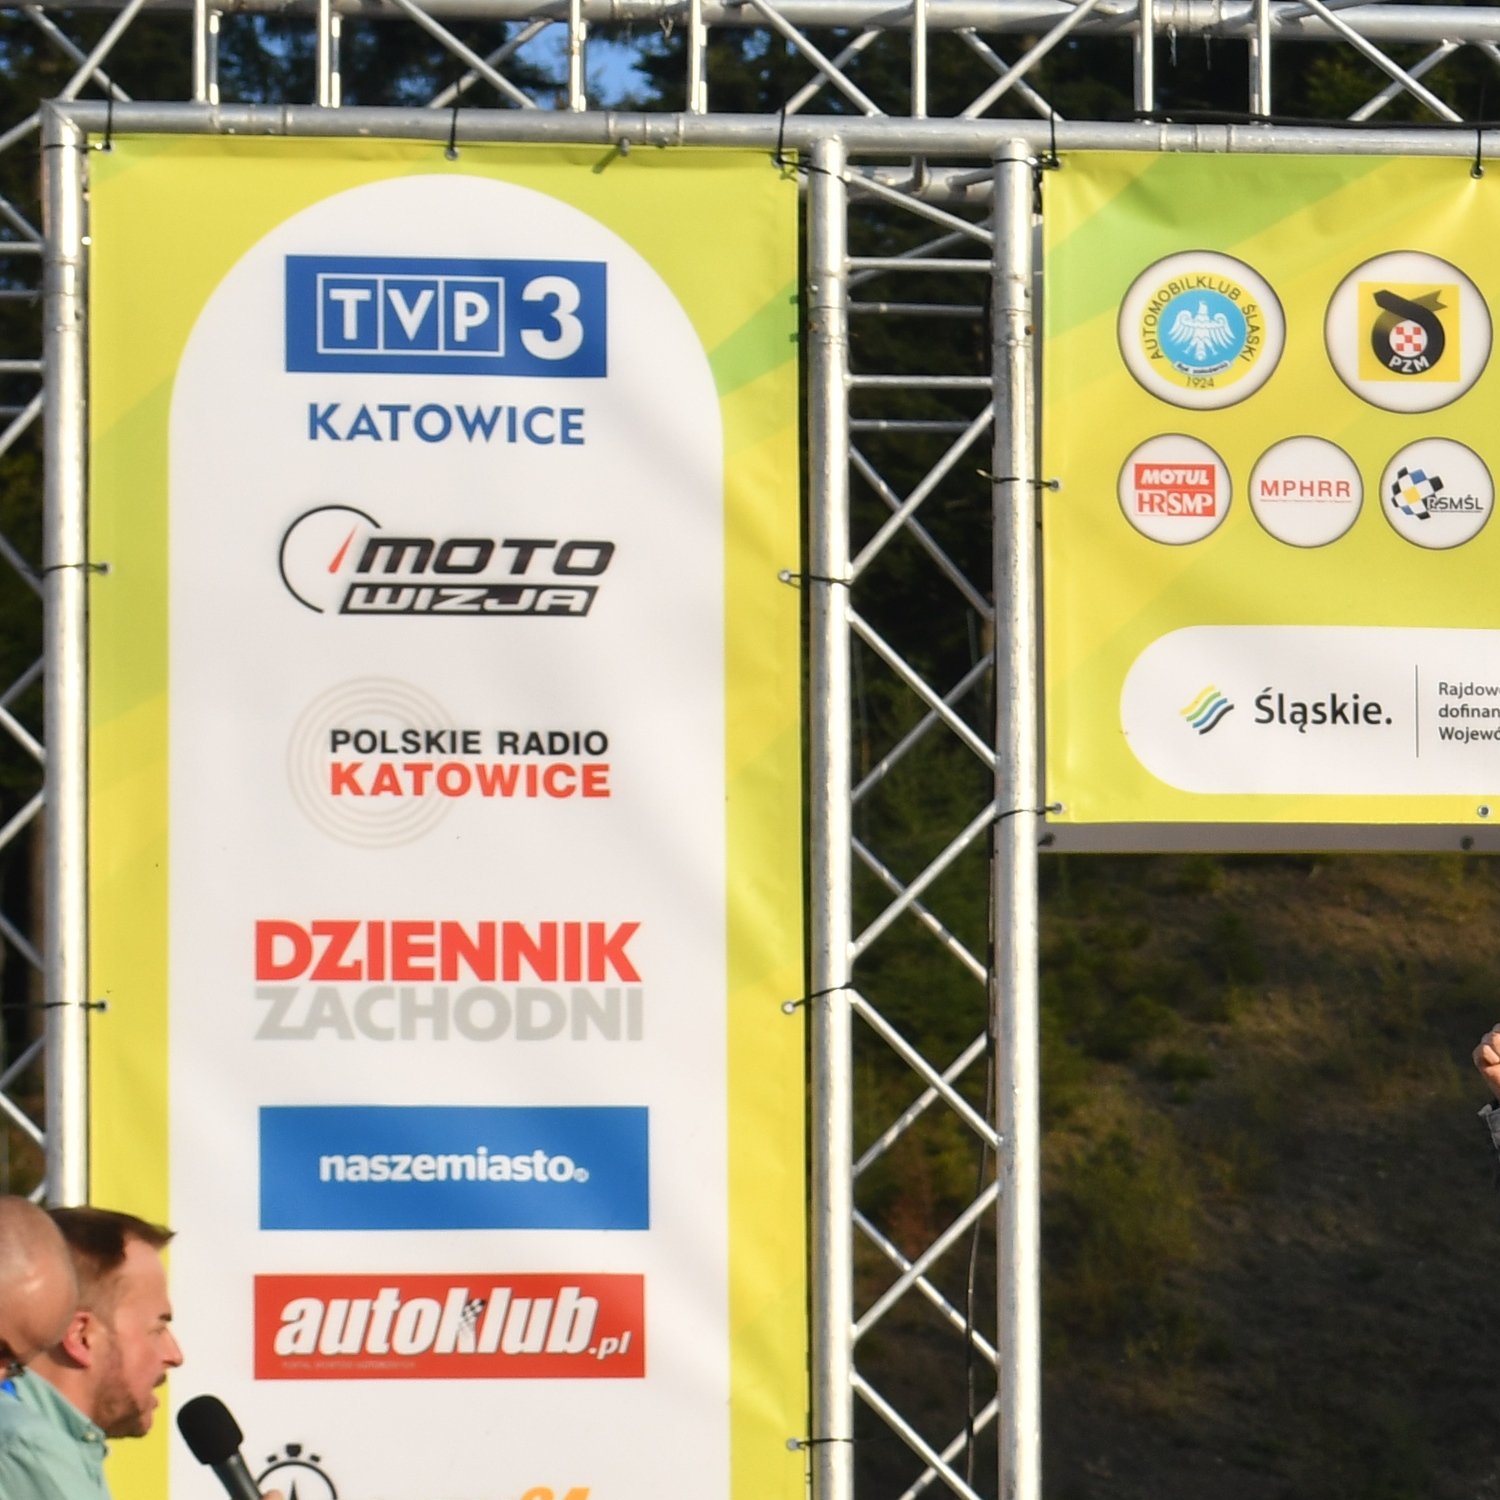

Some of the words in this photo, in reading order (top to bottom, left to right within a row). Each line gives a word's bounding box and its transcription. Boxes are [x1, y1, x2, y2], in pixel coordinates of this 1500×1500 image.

[329, 288, 491, 342] TVP
[520, 275, 585, 361] 3
[1388, 353, 1431, 373] PZM
[1186, 376, 1215, 389] 1924
[308, 403, 586, 445] KATOWICE
[1140, 469, 1210, 487] MOTUL
[1259, 480, 1351, 498] MPHRR
[1136, 492, 1214, 517] HRSMP
[356, 536, 616, 578] MOTO
[347, 585, 590, 615] WIZJA
[1253, 686, 1393, 733] Śląskie.
[330, 729, 482, 755] POLSKIE
[497, 730, 609, 756] RADIO
[330, 762, 612, 798] KATOWICE
[254, 919, 643, 983] DZIENNIK
[253, 986, 644, 1042] ZACHODNI
[274, 1286, 631, 1361] autoklub.pl
